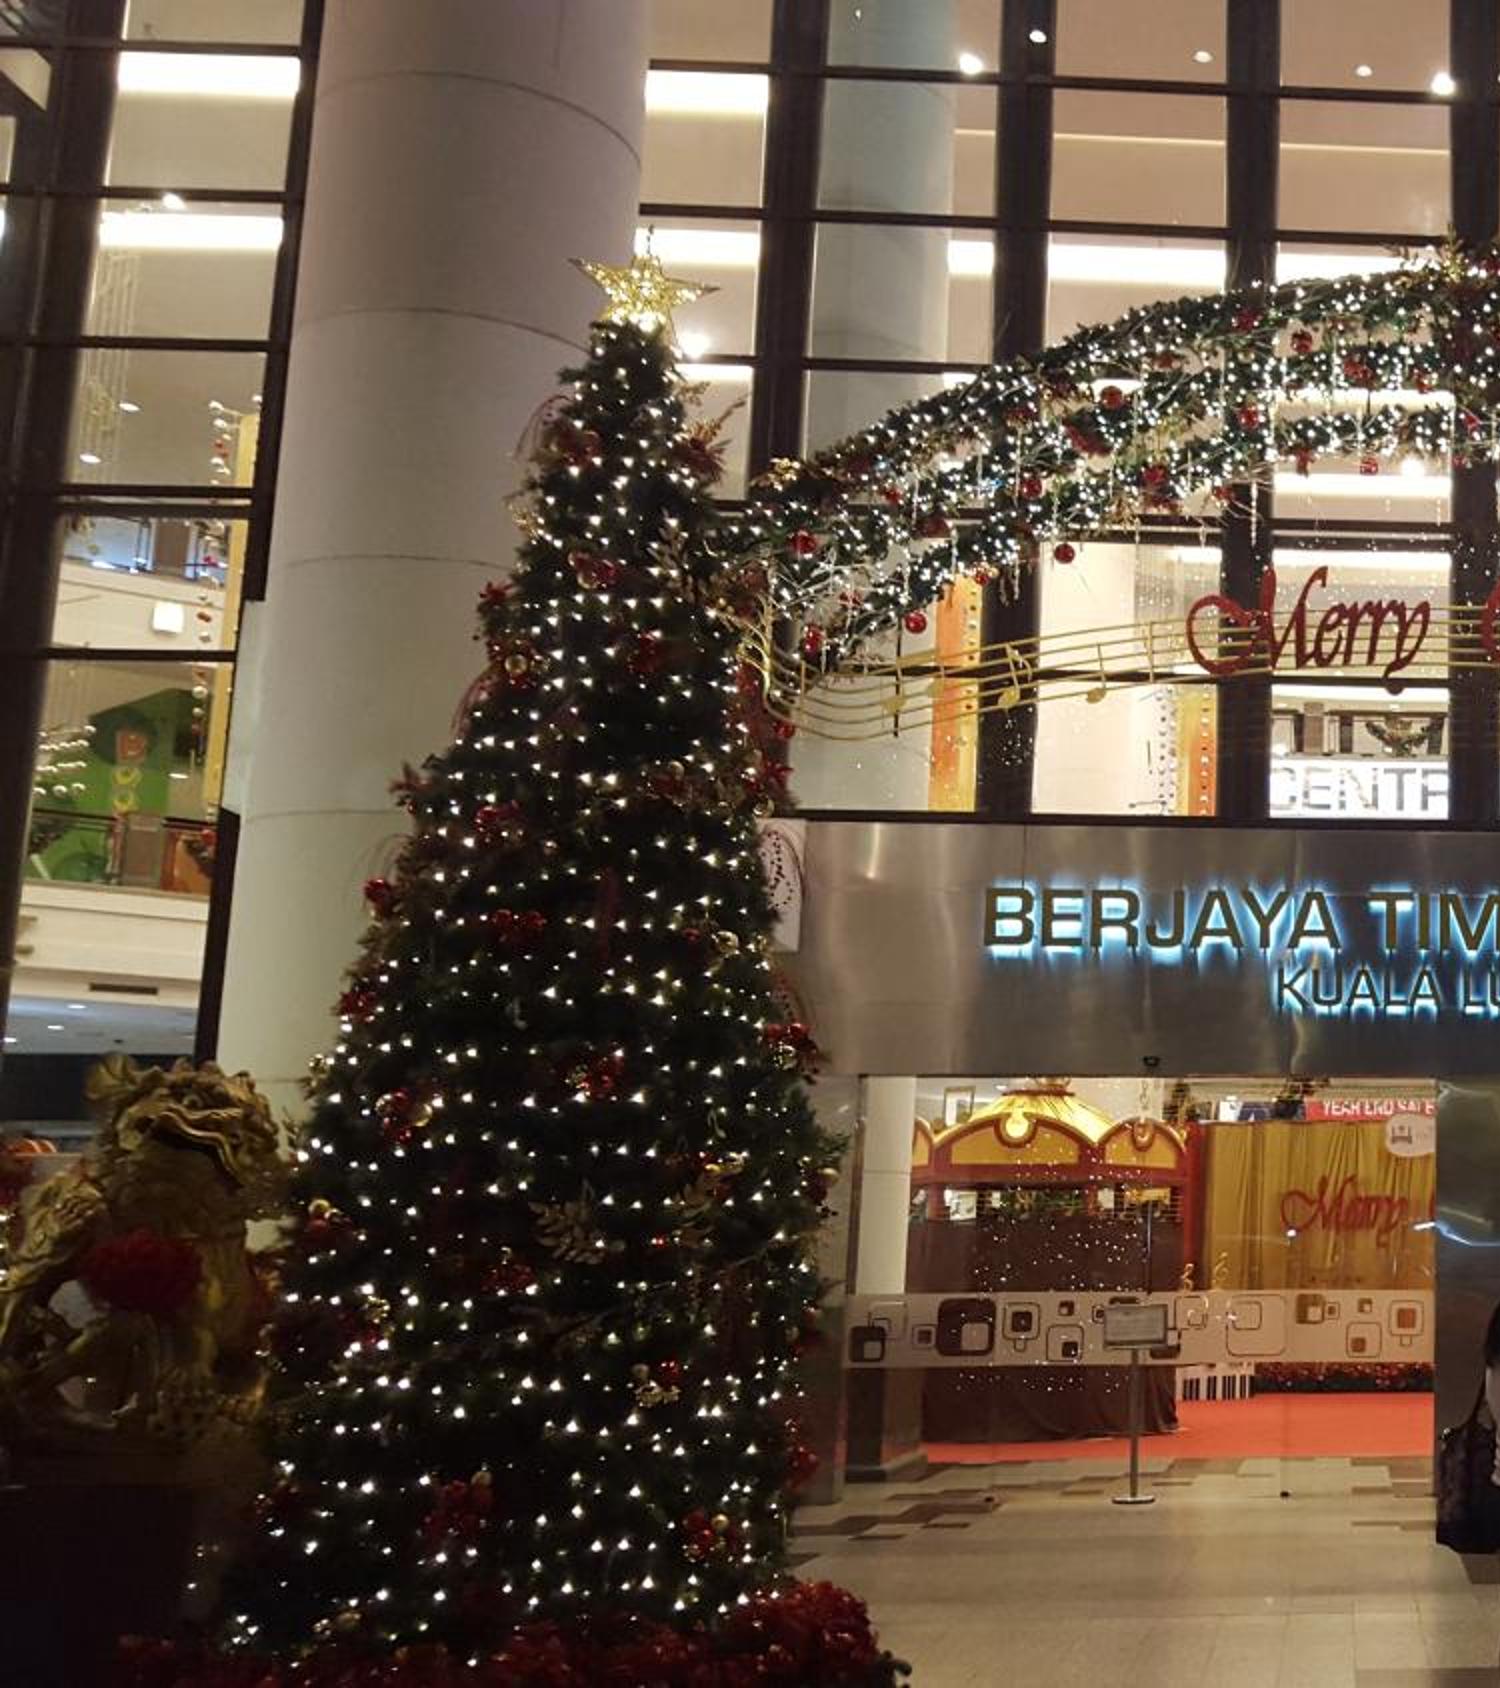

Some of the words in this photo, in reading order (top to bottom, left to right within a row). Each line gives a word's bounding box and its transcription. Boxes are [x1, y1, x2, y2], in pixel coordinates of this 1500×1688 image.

[1186, 566, 1430, 695] Merry
[984, 887, 1341, 949] BERJAYA
[1278, 968, 1442, 1009] KUALA
[1322, 1097, 1361, 1116] YEAR
[1364, 1097, 1394, 1115] END
